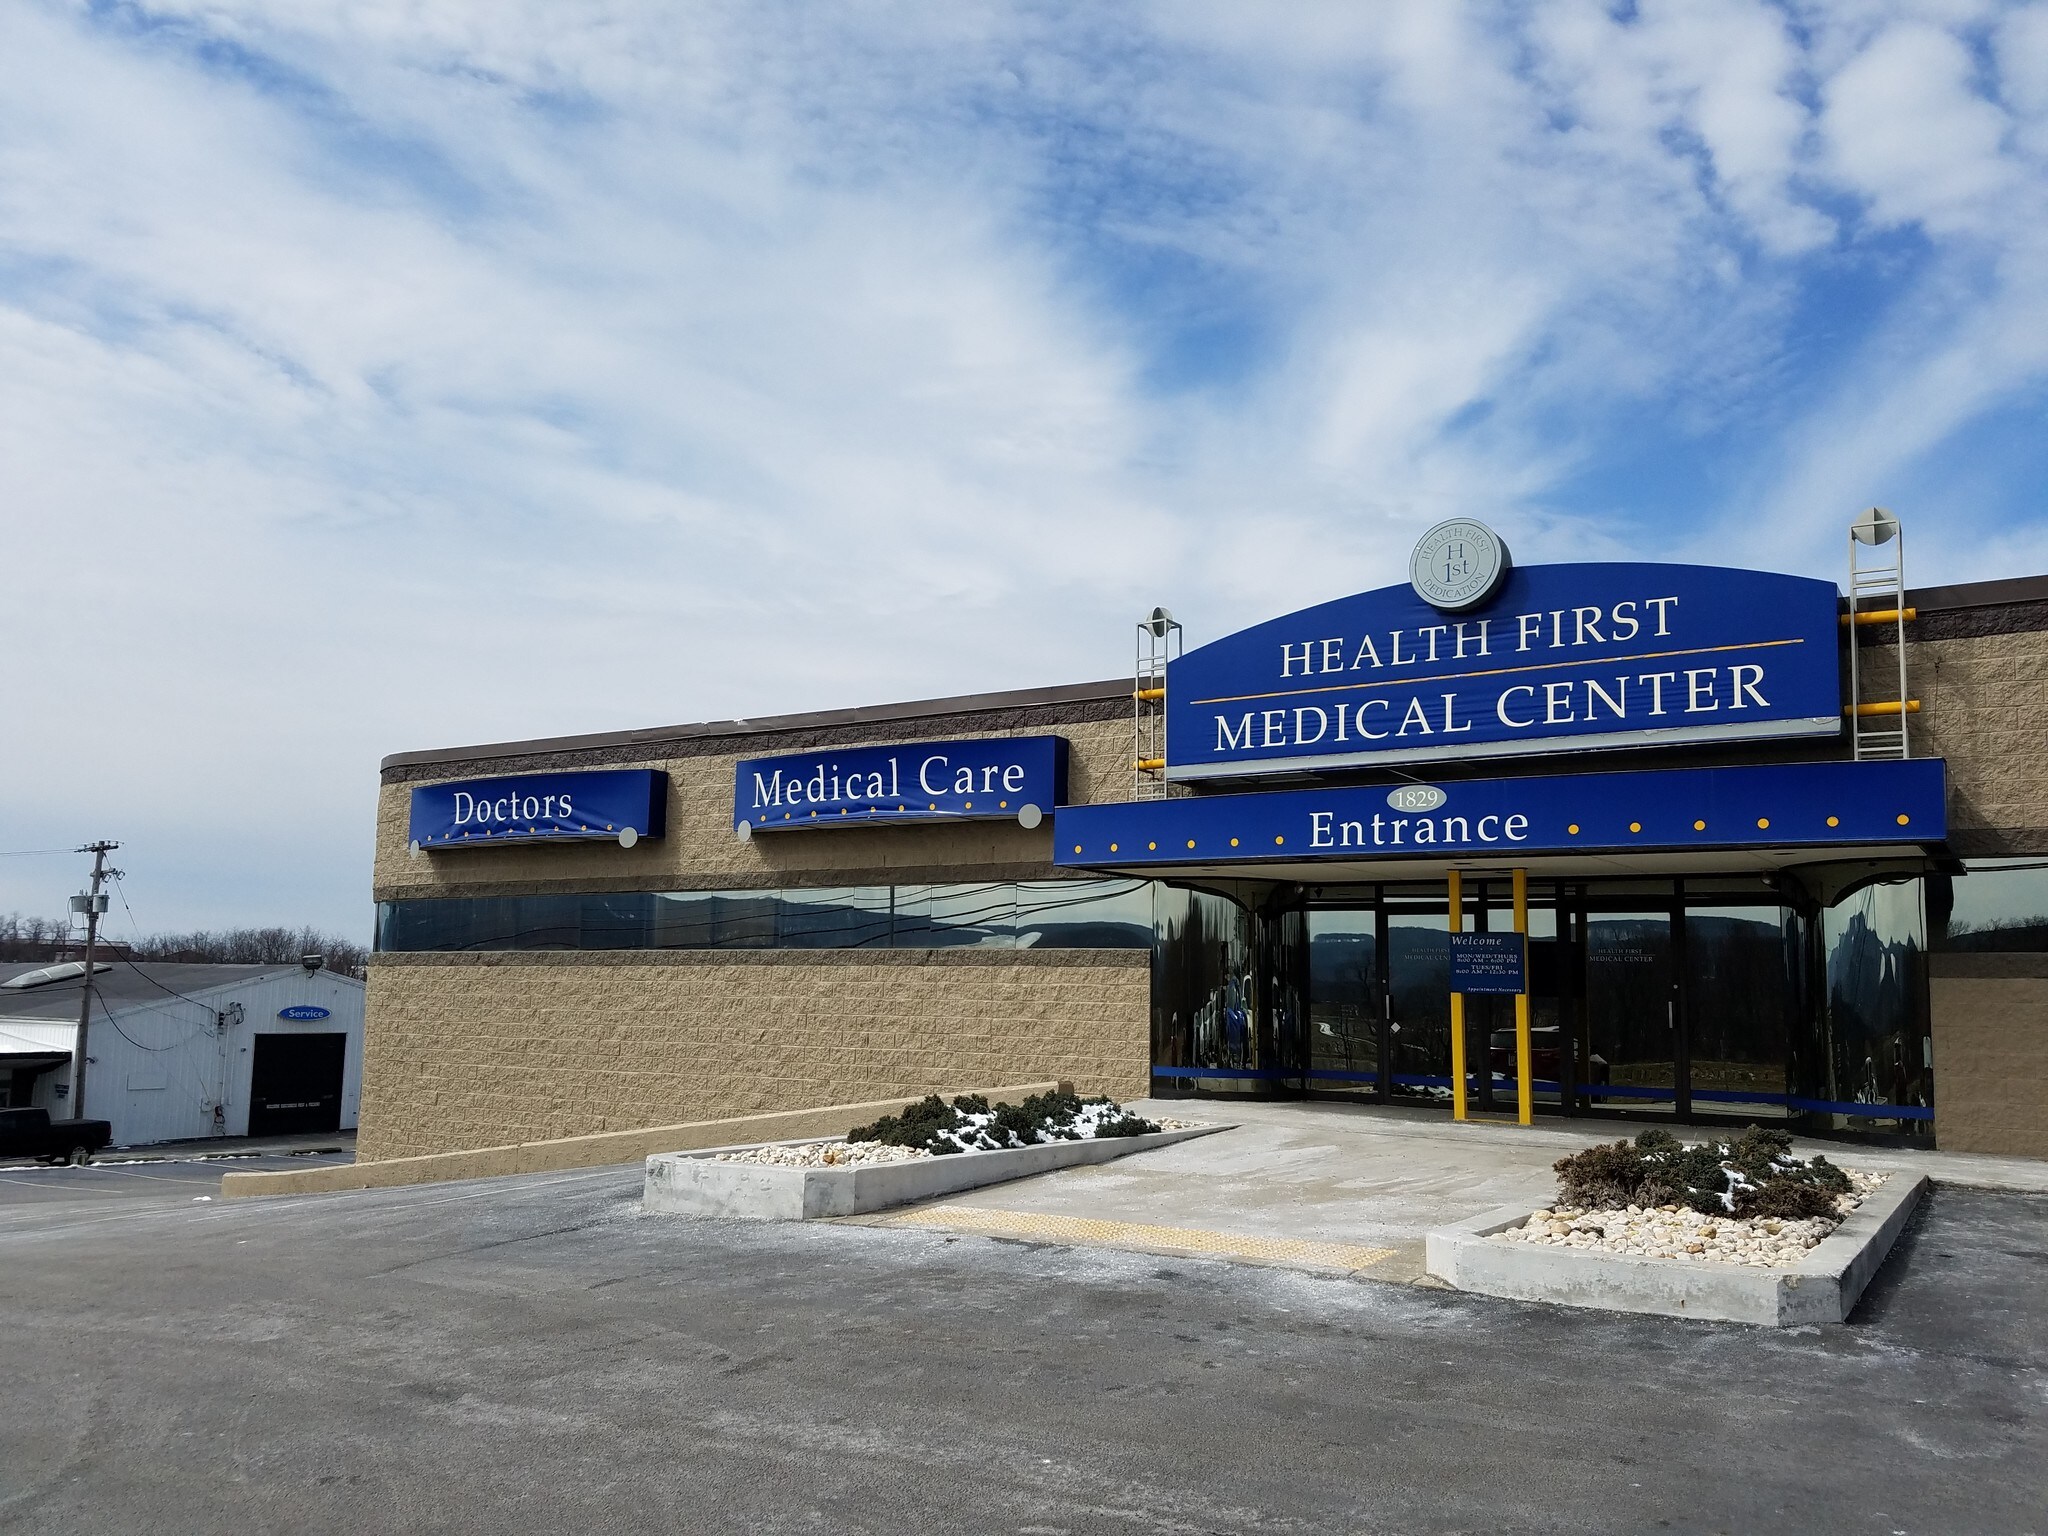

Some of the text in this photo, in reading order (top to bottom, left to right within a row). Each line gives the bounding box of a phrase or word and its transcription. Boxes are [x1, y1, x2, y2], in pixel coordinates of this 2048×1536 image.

[1421, 528, 1491, 560] HEALTH FIRST
[1446, 543, 1464, 560] H
[1423, 572, 1485, 598] DEDICATION
[1442, 559, 1470, 583] 1st
[1279, 596, 1679, 679] HEALTH FIRST
[1212, 663, 1771, 752] MEDICAL CENTER
[751, 754, 1025, 809] Medical Care
[453, 789, 574, 826] Doctors
[1396, 790, 1438, 808] 1829
[1308, 811, 1530, 848] Entrance
[1451, 935, 1502, 946] Welcome
[288, 1009, 324, 1018] Service
